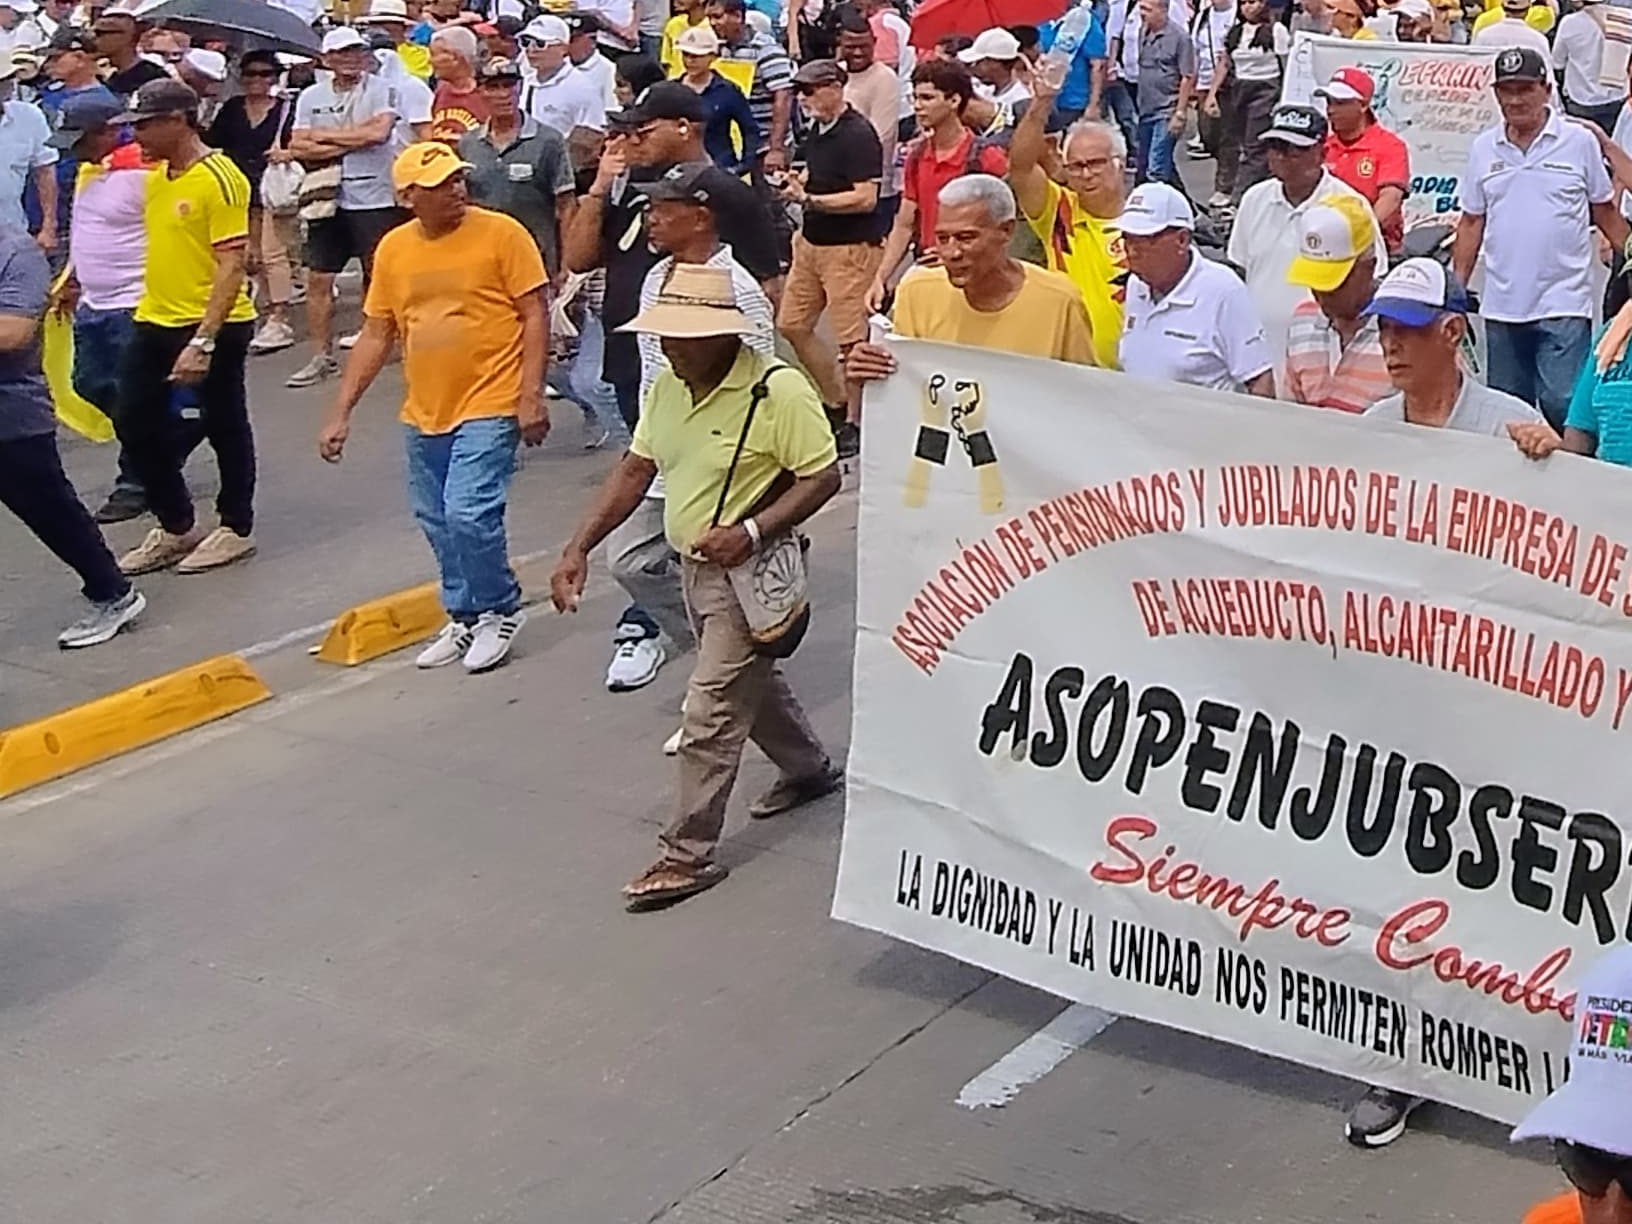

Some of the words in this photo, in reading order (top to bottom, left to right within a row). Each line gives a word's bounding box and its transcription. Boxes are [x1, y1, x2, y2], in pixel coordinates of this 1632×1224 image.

[1398, 59, 1494, 91] EFRAIN
[892, 537, 1015, 677] ASOCIACIÓN
[995, 518, 1047, 580] DE
[1028, 471, 1185, 564] PENSIONADOS
[1189, 468, 1205, 528] Y
[1218, 464, 1358, 532] JUBILADOS
[1365, 472, 1400, 538] DE
[1405, 479, 1439, 546] LA
[1446, 487, 1579, 588] EMPRESA
[1578, 534, 1628, 608] DE
[1132, 579, 1178, 638] DE
[1172, 577, 1338, 661] ACUEDUCTO,
[1343, 590, 1607, 719] ALCANTARILLADO
[1090, 816, 1352, 947] Siempre
[896, 849, 922, 909] LA
[931, 861, 1038, 946] DIGNIDAD
[1047, 897, 1061, 955] Y
[1069, 907, 1096, 971] LA
[1107, 919, 1201, 997] UNIDAD
[1215, 948, 1268, 1015] NOS
[1280, 966, 1407, 1060] PERMITEN
[1420, 1010, 1532, 1096] ROMPER
